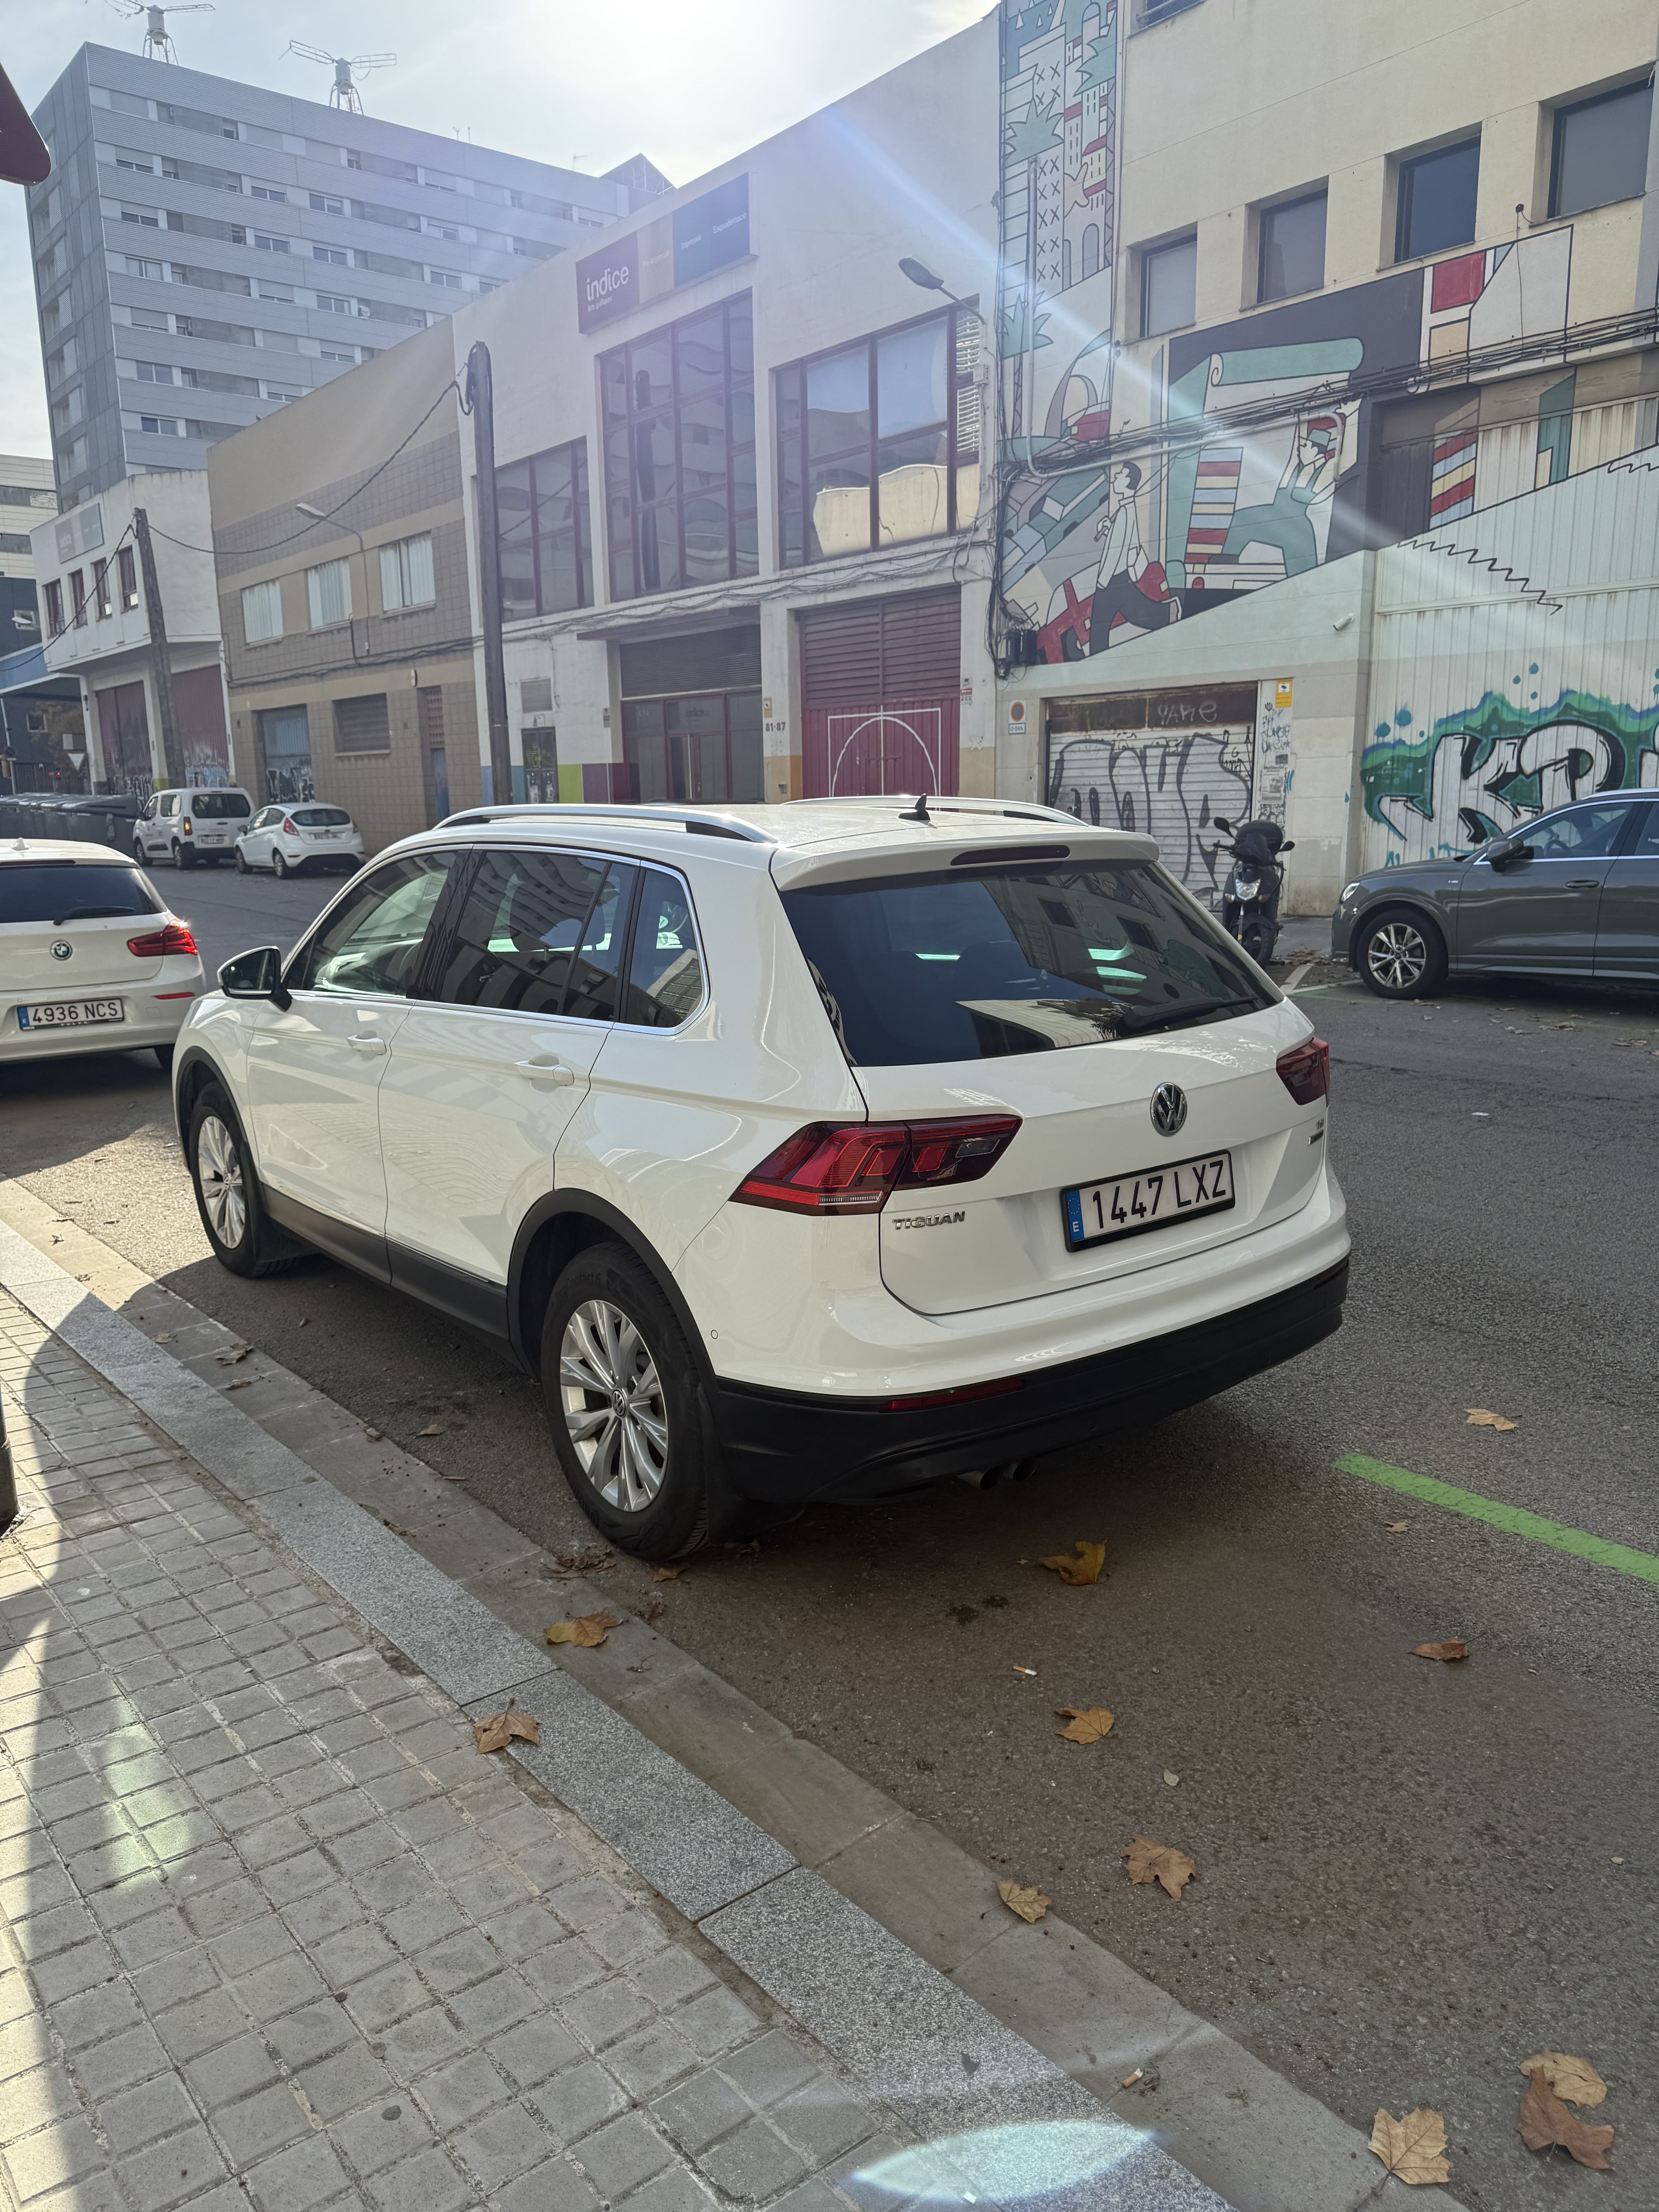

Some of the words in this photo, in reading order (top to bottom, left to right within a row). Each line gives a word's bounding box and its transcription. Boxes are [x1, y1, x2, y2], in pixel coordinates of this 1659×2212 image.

[713, 211, 747, 234] Enquadernació
[33, 1005, 79, 1023] 4936
[84, 1002, 118, 1019] NCS
[1092, 1175, 1163, 1229] 1447
[1174, 1159, 1226, 1208] LXZ
[892, 1210, 965, 1230] TIGUAN
[1072, 1221, 1079, 1233] E
